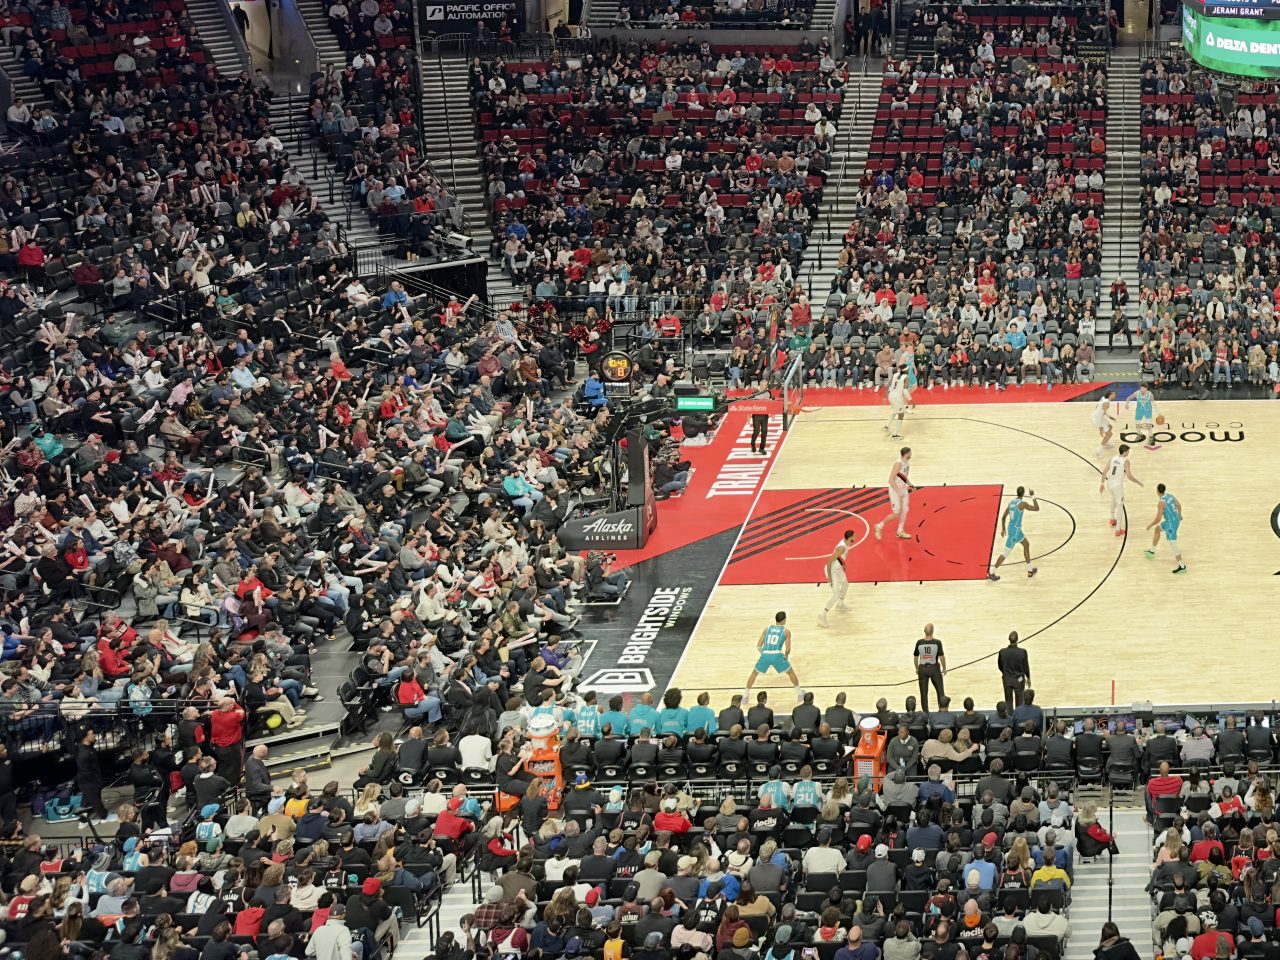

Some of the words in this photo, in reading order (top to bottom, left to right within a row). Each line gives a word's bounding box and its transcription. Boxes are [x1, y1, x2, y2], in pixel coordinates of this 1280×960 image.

[446, 4, 481, 12] PACIFIC
[1212, 6, 1238, 15] JERAMI
[1240, 7, 1265, 16] GRANT.
[447, 11, 506, 20] AUTOMATION
[1216, 37, 1248, 53] DELTA
[1119, 430, 1245, 445] moda
[705, 460, 769, 499] TRAIL
[582, 518, 634, 532] Alaska.
[584, 534, 628, 542] AIRLINES
[663, 587, 693, 628] WINDOWS
[616, 587, 681, 665] BRIGHTSIDE
[766, 635, 779, 645] 10
[924, 646, 931, 654] 10
[577, 719, 595, 729] 24
